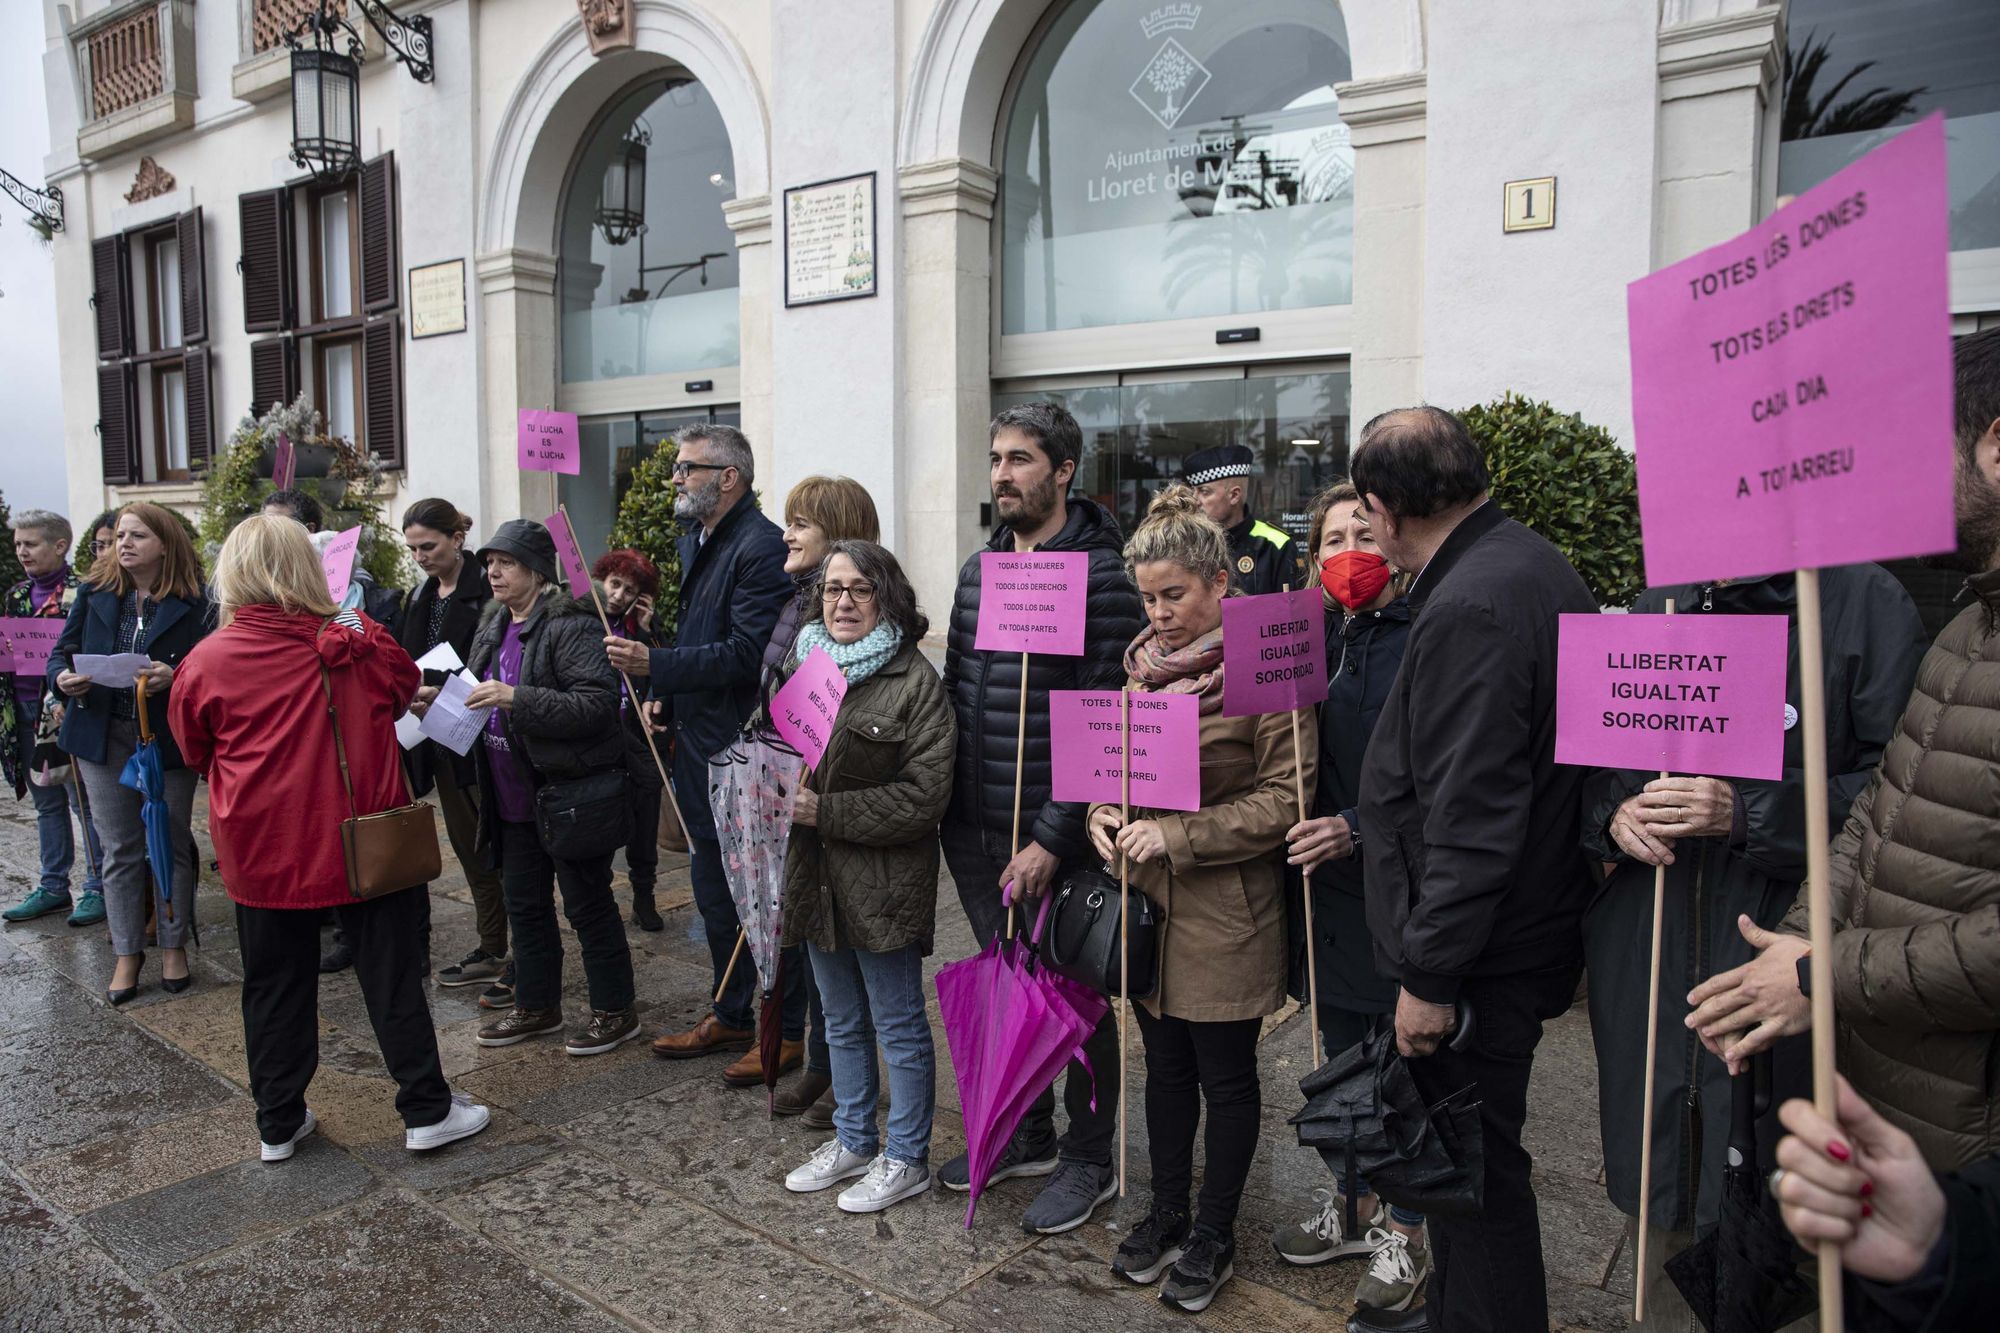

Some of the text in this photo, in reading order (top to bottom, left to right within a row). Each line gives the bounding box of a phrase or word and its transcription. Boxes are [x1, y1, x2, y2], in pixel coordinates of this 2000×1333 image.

[1105, 135, 1237, 173] Ajuntament de
[1088, 172, 1157, 203] Lloret
[1164, 165, 1194, 191] de
[1521, 187, 1536, 219] 1
[1689, 190, 1868, 301] TOTES LES DONES
[1710, 327, 1763, 364] TOTS
[1794, 280, 1855, 330] DRETS
[1796, 374, 1829, 406] DIA
[527, 424, 564, 434] TU LUCHA
[542, 439, 551, 447] ES
[540, 451, 565, 460] LUCHA
[1736, 475, 1751, 499] A
[1790, 447, 1854, 483] ARREU
[1282, 512, 1307, 521] Horari
[998, 562, 1065, 570] TODAS LAS MUJERES
[995, 582, 1016, 590] TODOS
[1030, 583, 1068, 591] DERECHOS
[1003, 603, 1023, 611] TODOS
[1039, 604, 1055, 612] DIAS
[29, 631, 47, 639] TEVA
[999, 623, 1057, 633] EN TODAS PARTES
[1260, 619, 1309, 638] LIBERTAD
[1261, 641, 1310, 661] IGUALTAD
[1607, 652, 1727, 672] LLIBERTAT
[1255, 662, 1314, 685] SORORIDAD
[1612, 682, 1721, 703] IGUALTAT
[808, 691, 828, 717] MEJOR
[1081, 698, 1168, 710] TOTES LS DONES
[1088, 722, 1112, 731] TOTS
[1133, 724, 1162, 734] DRETS
[1602, 711, 1730, 734] SORORITAT
[1104, 746, 1147, 757] CAD DIA
[1094, 769, 1101, 777] A
[1128, 771, 1157, 782] ARREU
